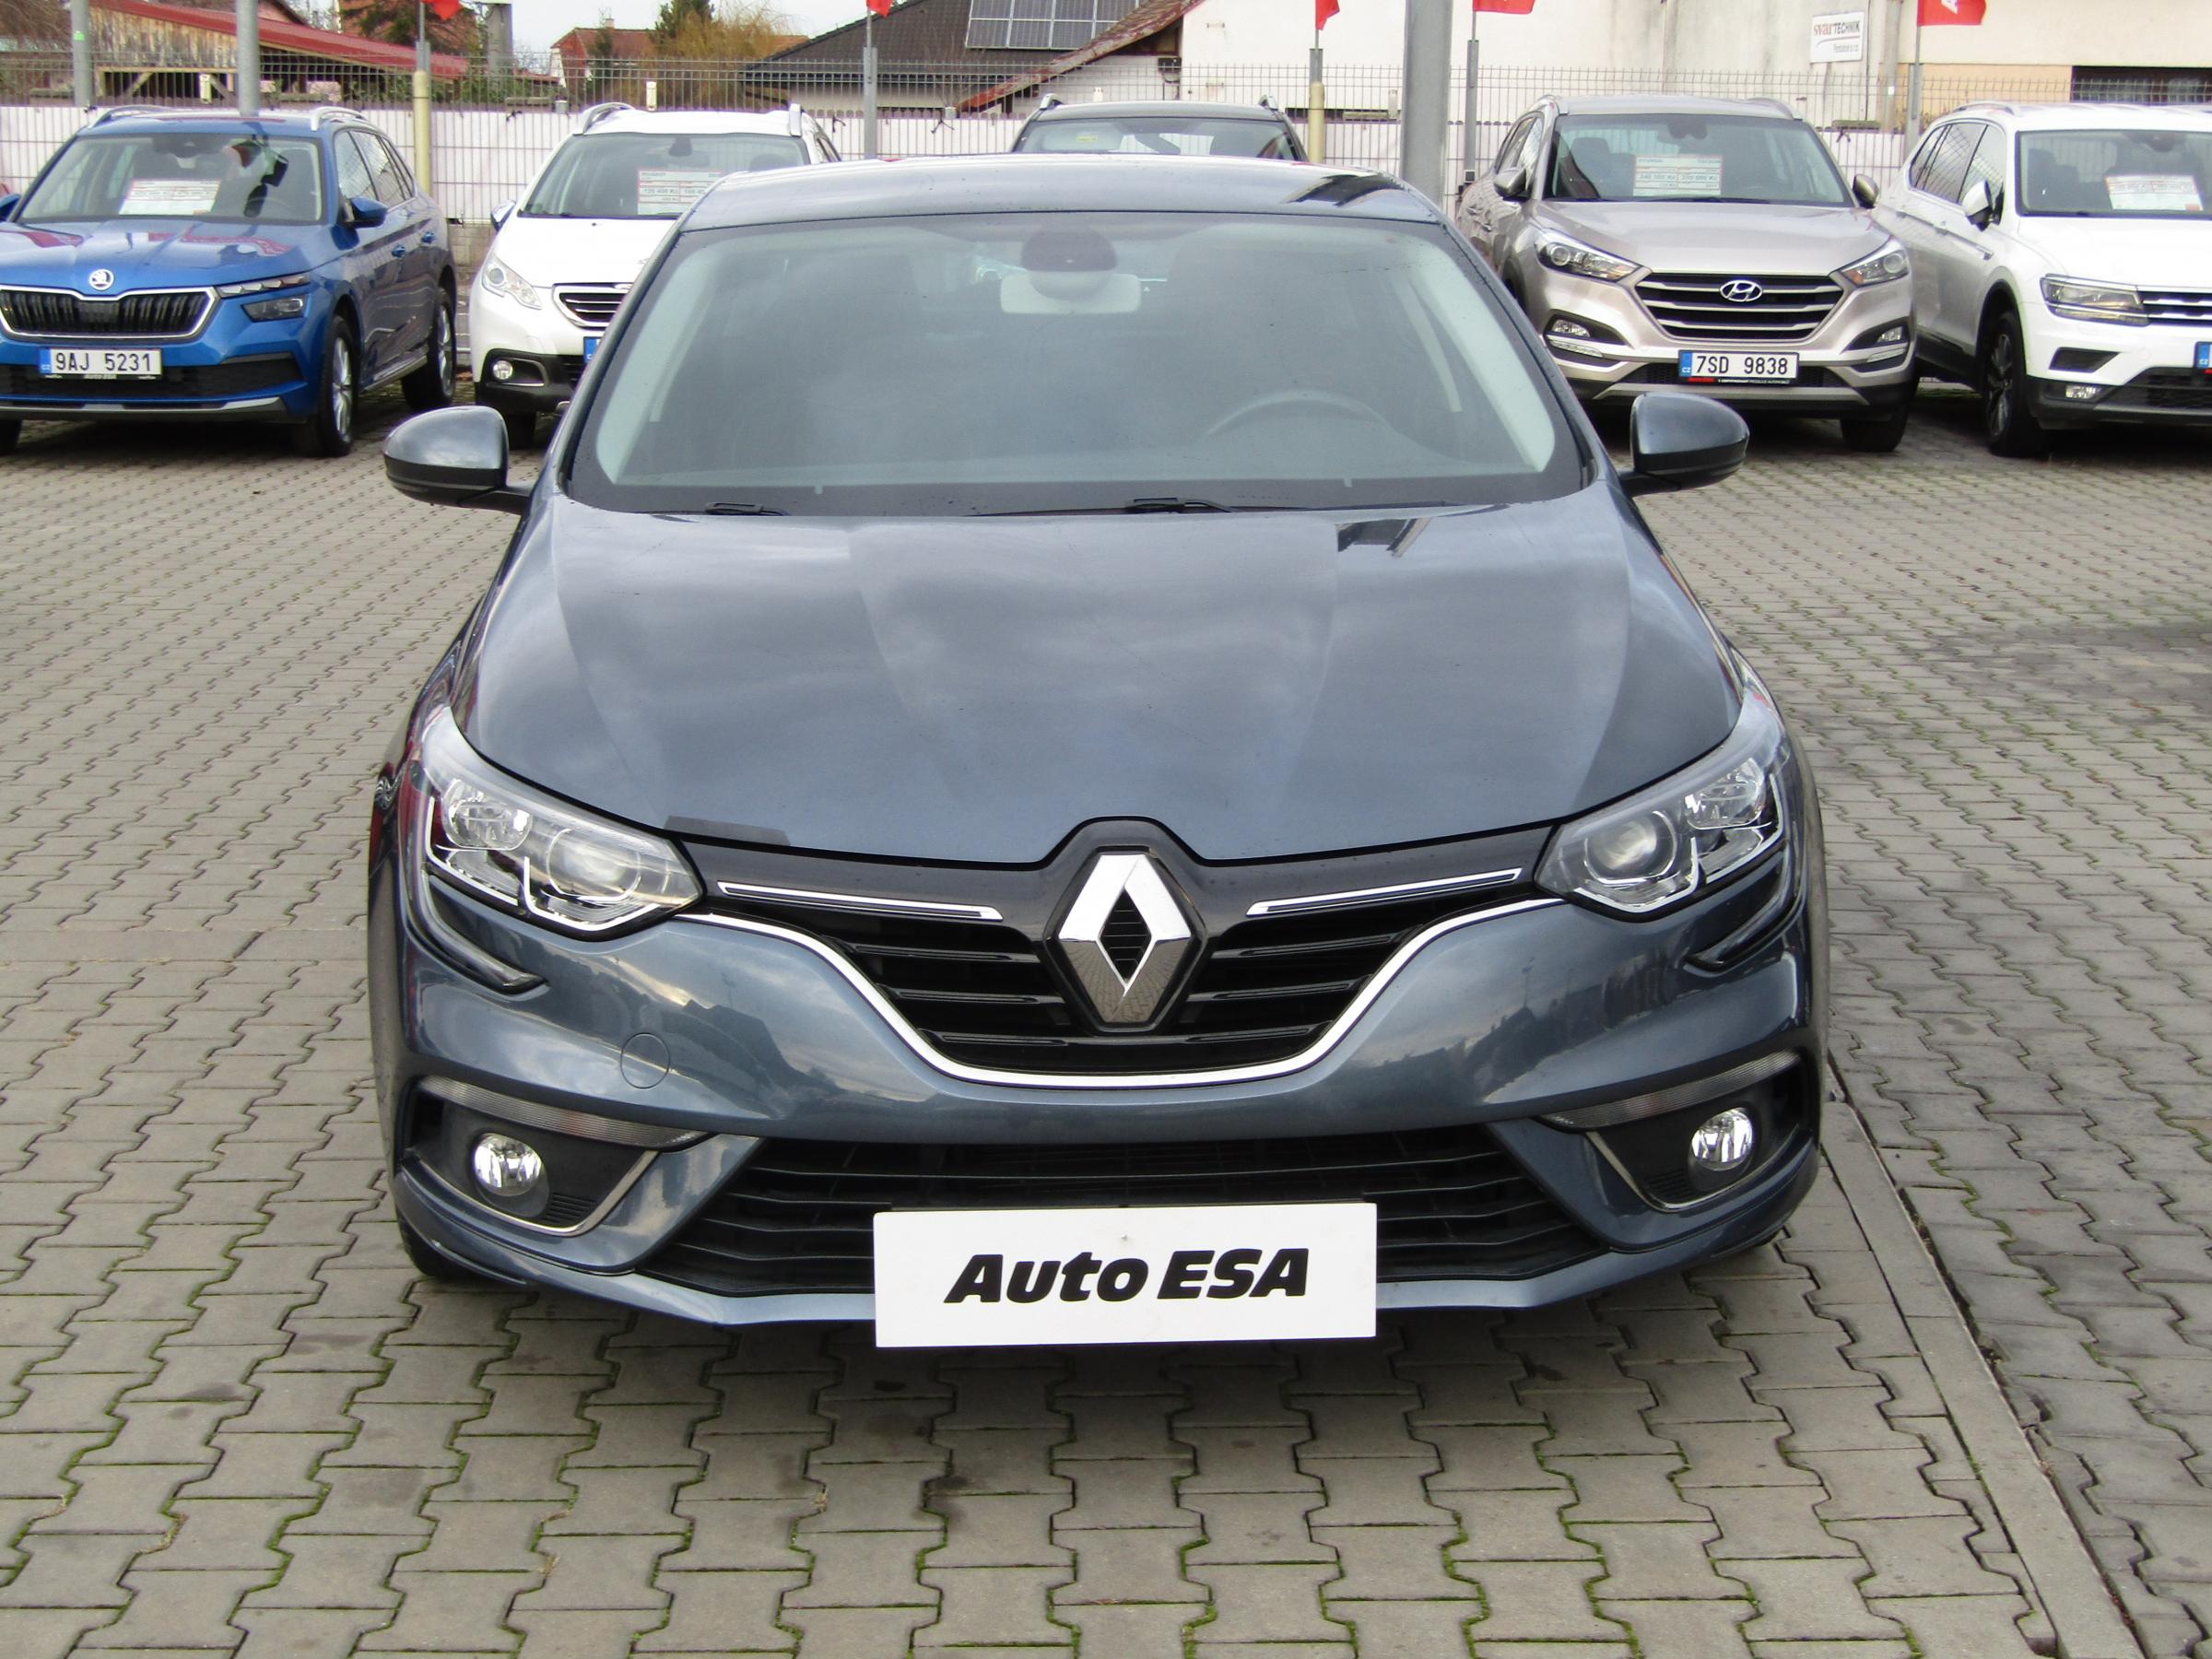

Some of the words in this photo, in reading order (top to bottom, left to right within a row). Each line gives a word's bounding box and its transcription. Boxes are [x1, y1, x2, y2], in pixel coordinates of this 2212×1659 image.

[55, 352, 89, 371] 9AJ
[104, 352, 150, 371] 5231
[1696, 355, 1729, 374] 7SD
[1744, 357, 1788, 375] 9838
[943, 1252, 1149, 1303] Auto
[1157, 1248, 1309, 1300] ESA
